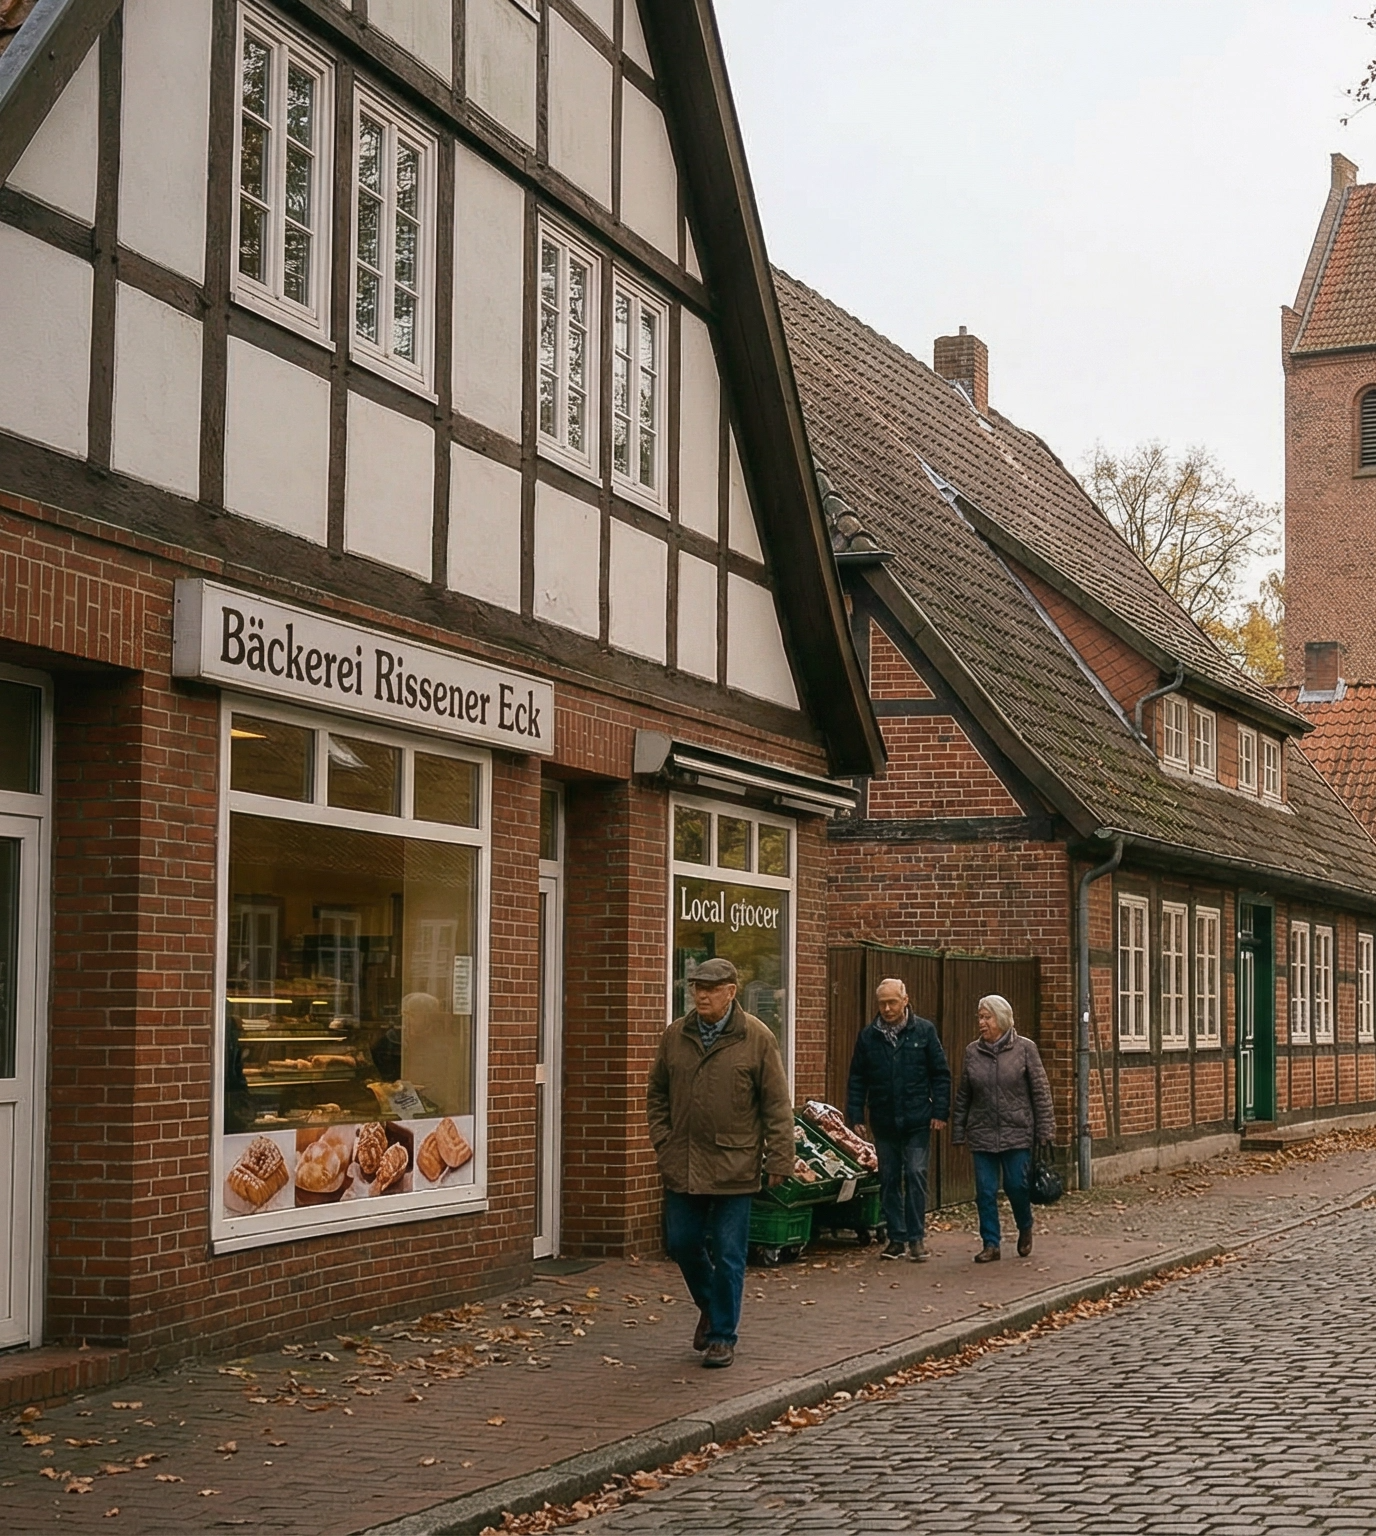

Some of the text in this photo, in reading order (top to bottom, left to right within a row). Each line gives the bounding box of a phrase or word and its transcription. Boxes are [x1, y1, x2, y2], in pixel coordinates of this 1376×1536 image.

[220, 606, 542, 739] Bäckerei Rissener Eck
[680, 886, 725, 924] Local
